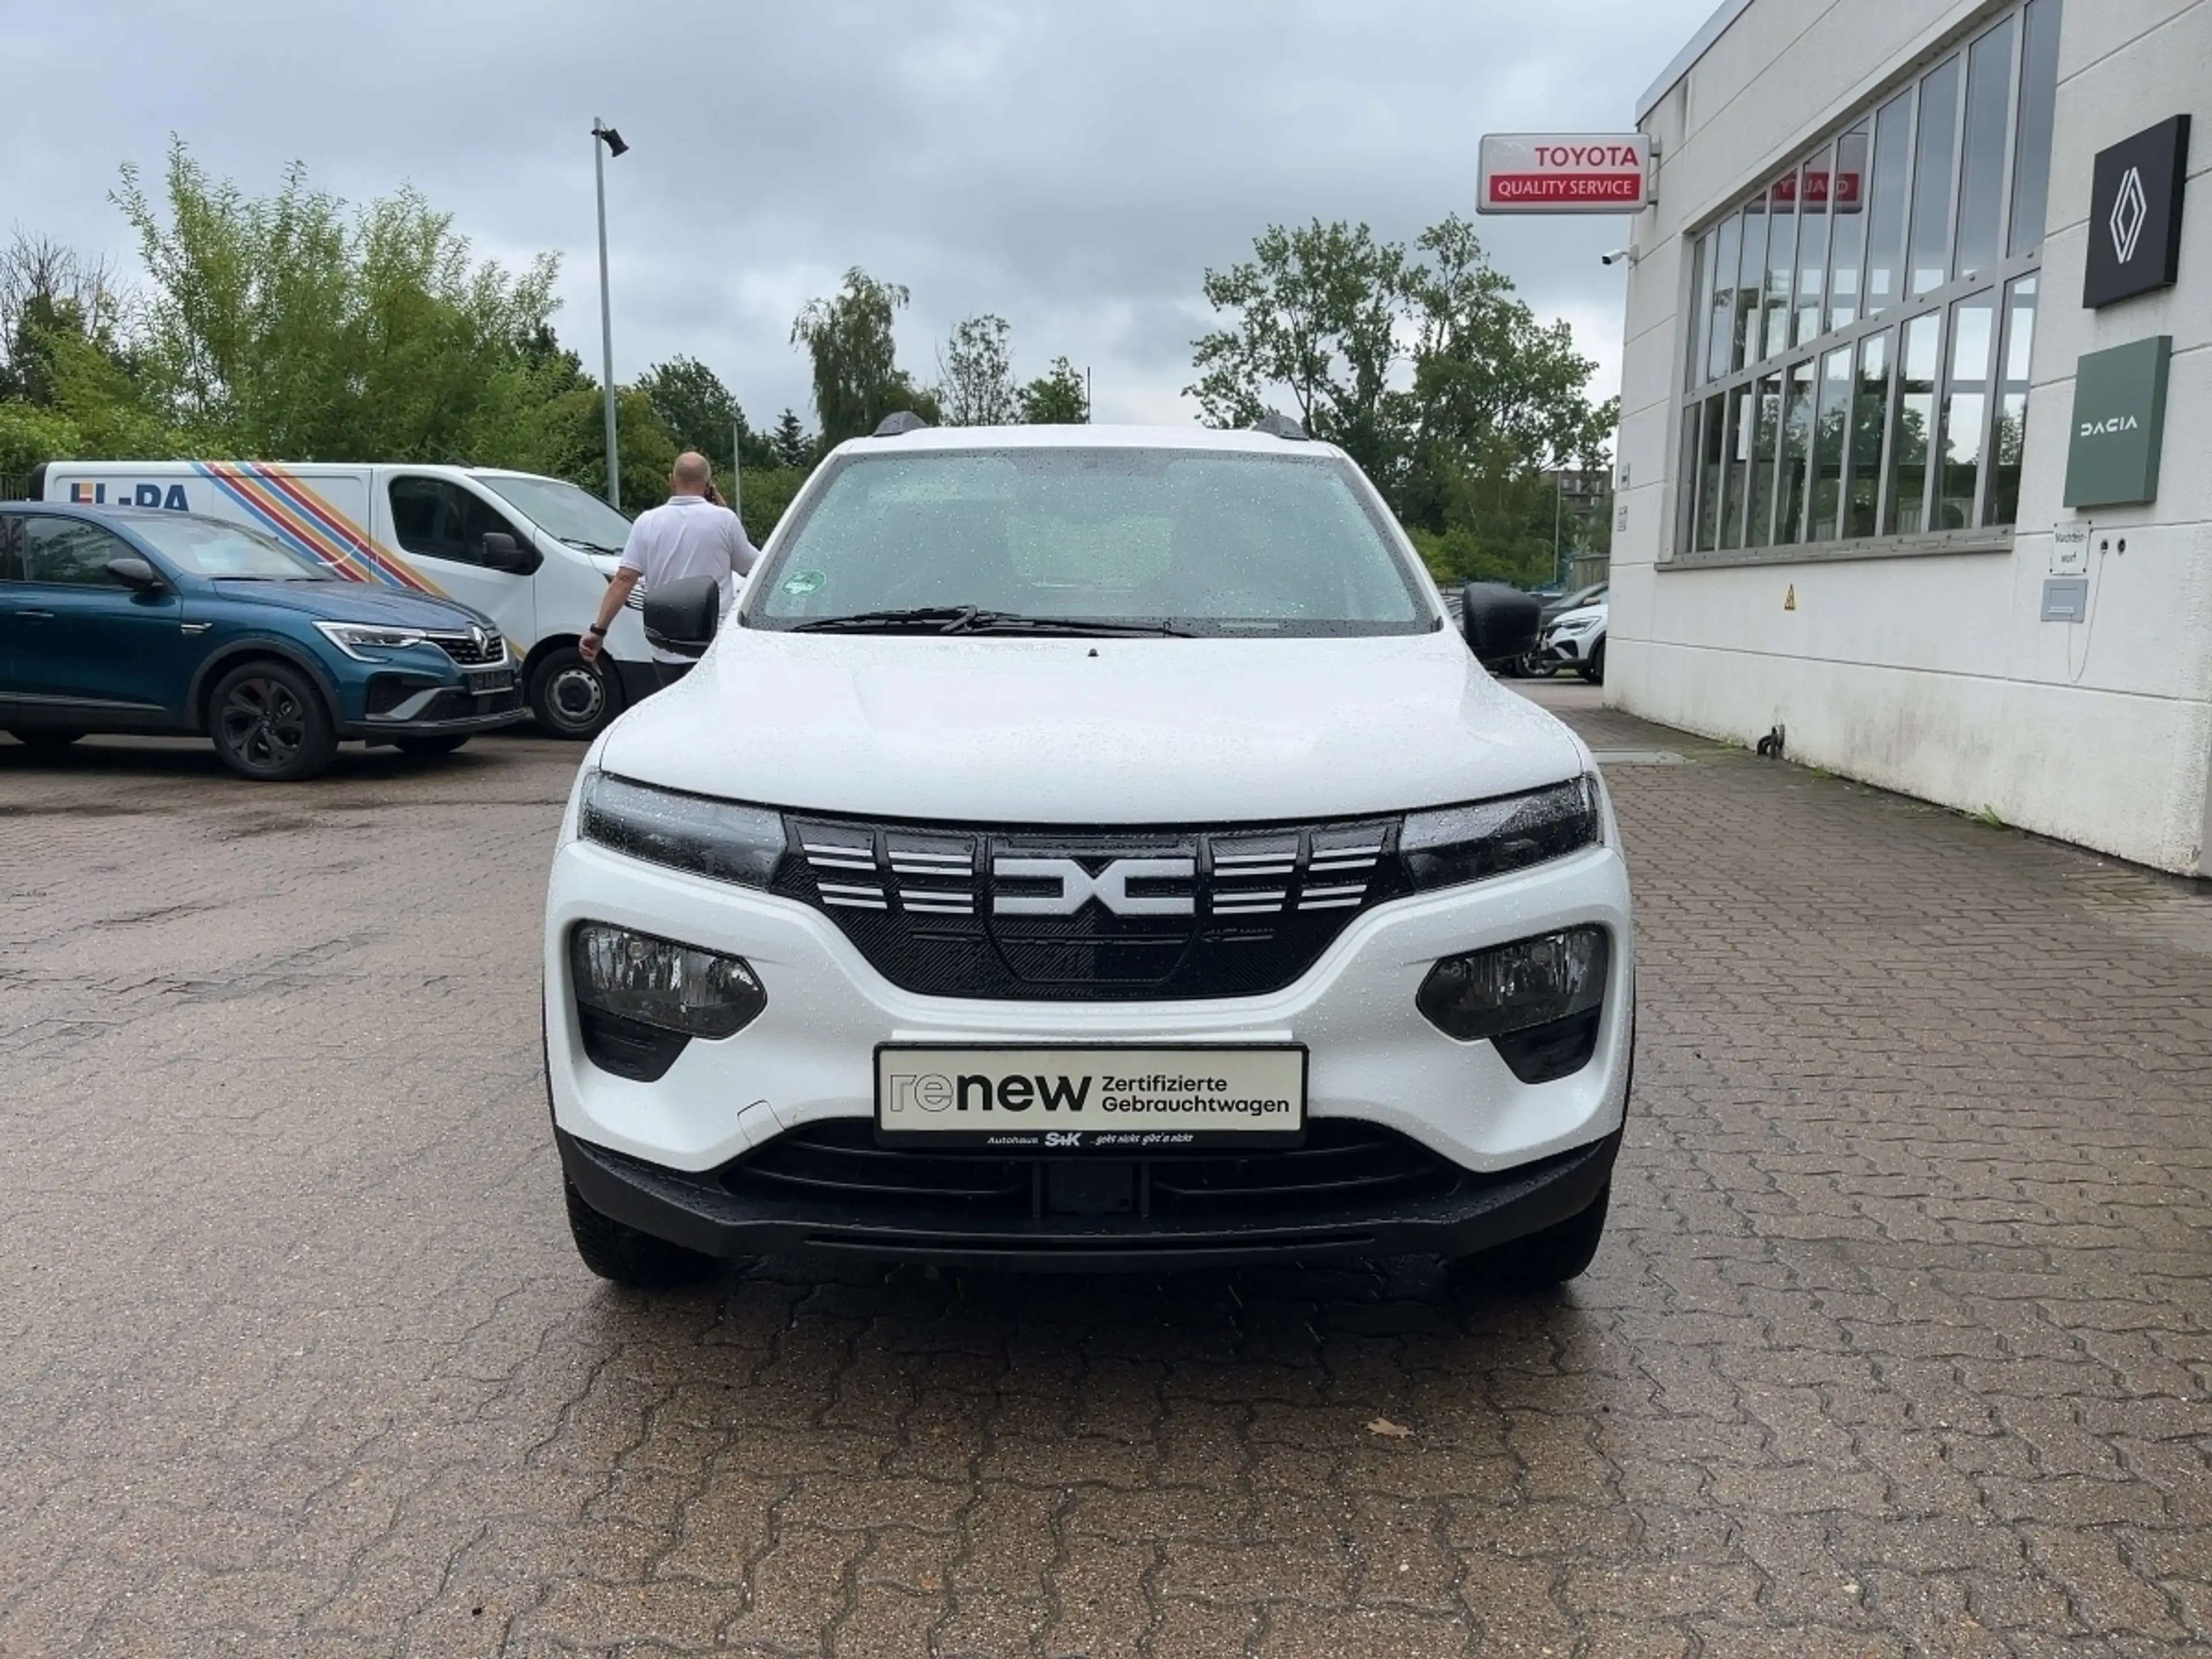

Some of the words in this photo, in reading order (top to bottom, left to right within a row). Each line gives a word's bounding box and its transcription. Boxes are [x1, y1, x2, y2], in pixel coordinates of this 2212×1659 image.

[1535, 146, 1639, 166] TOYOTA
[1498, 180, 1567, 198] QUALITY
[1569, 180, 1632, 195] SERVICE
[2080, 414, 2138, 437] DACIA
[889, 1073, 1093, 1112] renew
[1101, 1074, 1228, 1092] Zertifizierte
[1101, 1095, 1290, 1116] Gebrauchtwagen
[987, 1136, 1039, 1145] Autohaus
